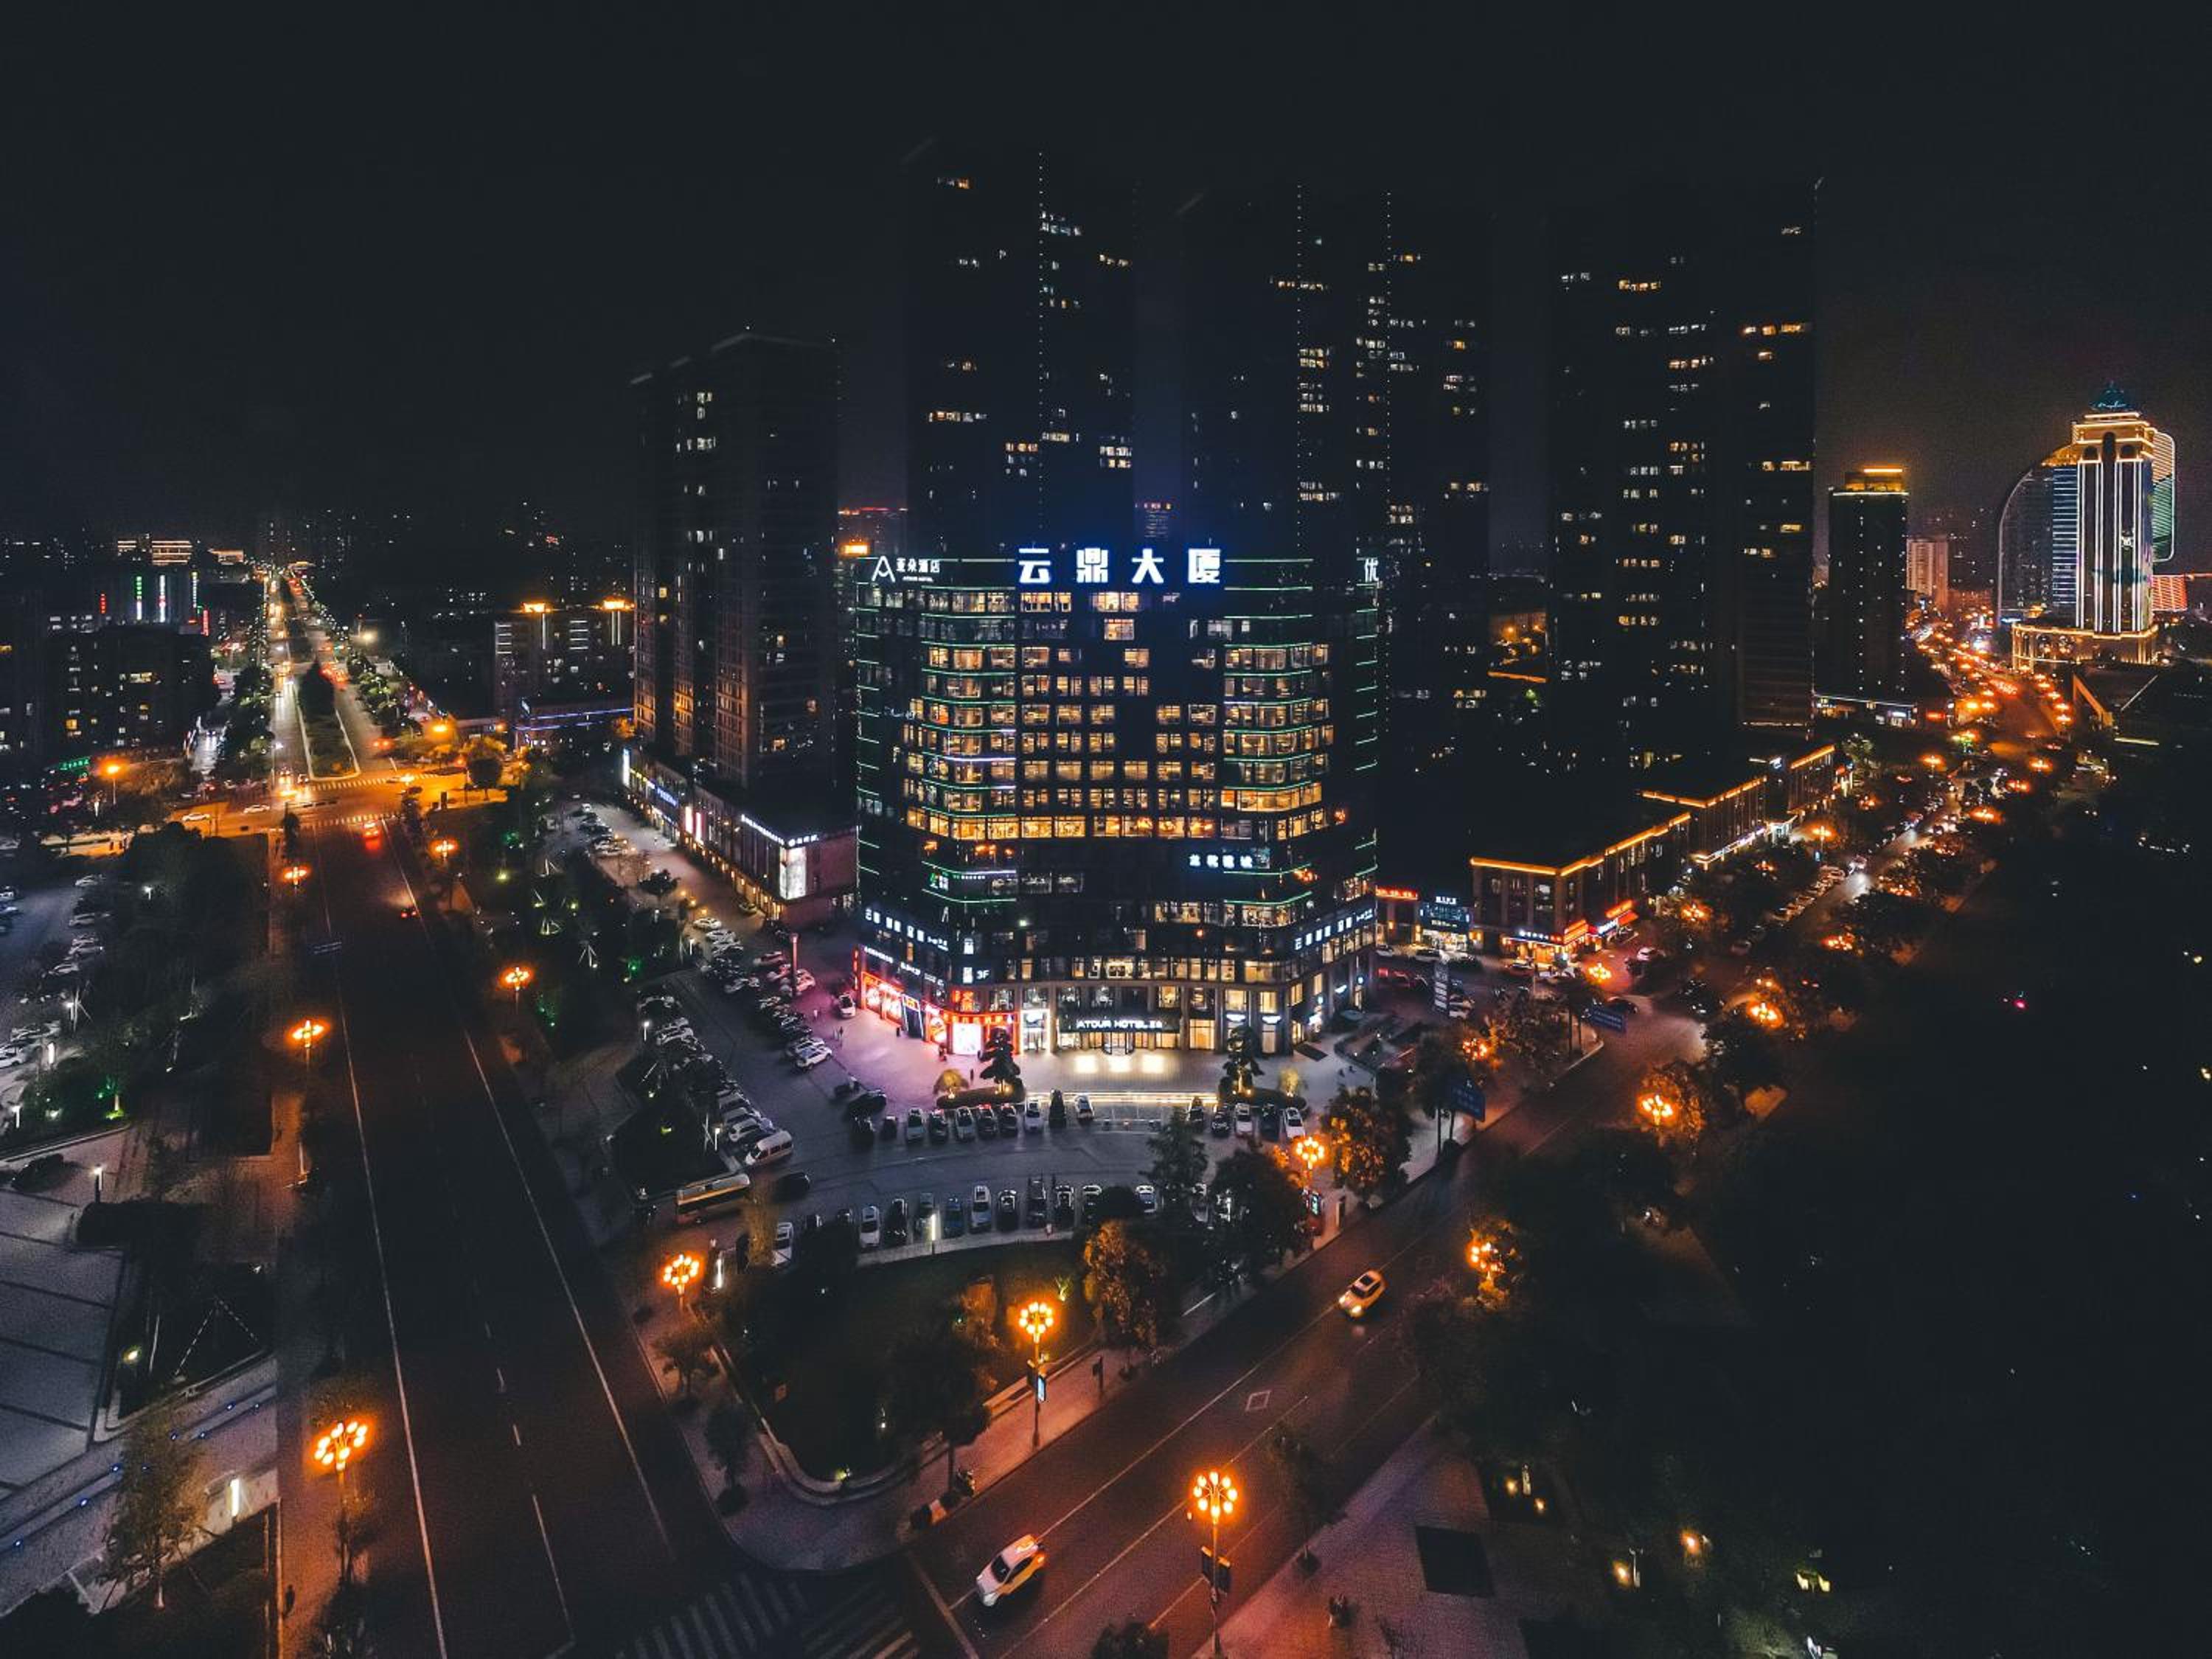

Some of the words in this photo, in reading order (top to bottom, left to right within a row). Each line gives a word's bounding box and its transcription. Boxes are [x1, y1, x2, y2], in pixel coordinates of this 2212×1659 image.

[896, 557, 941, 573] 亚朵酒店
[1018, 548, 1221, 584] 云鼎大厦
